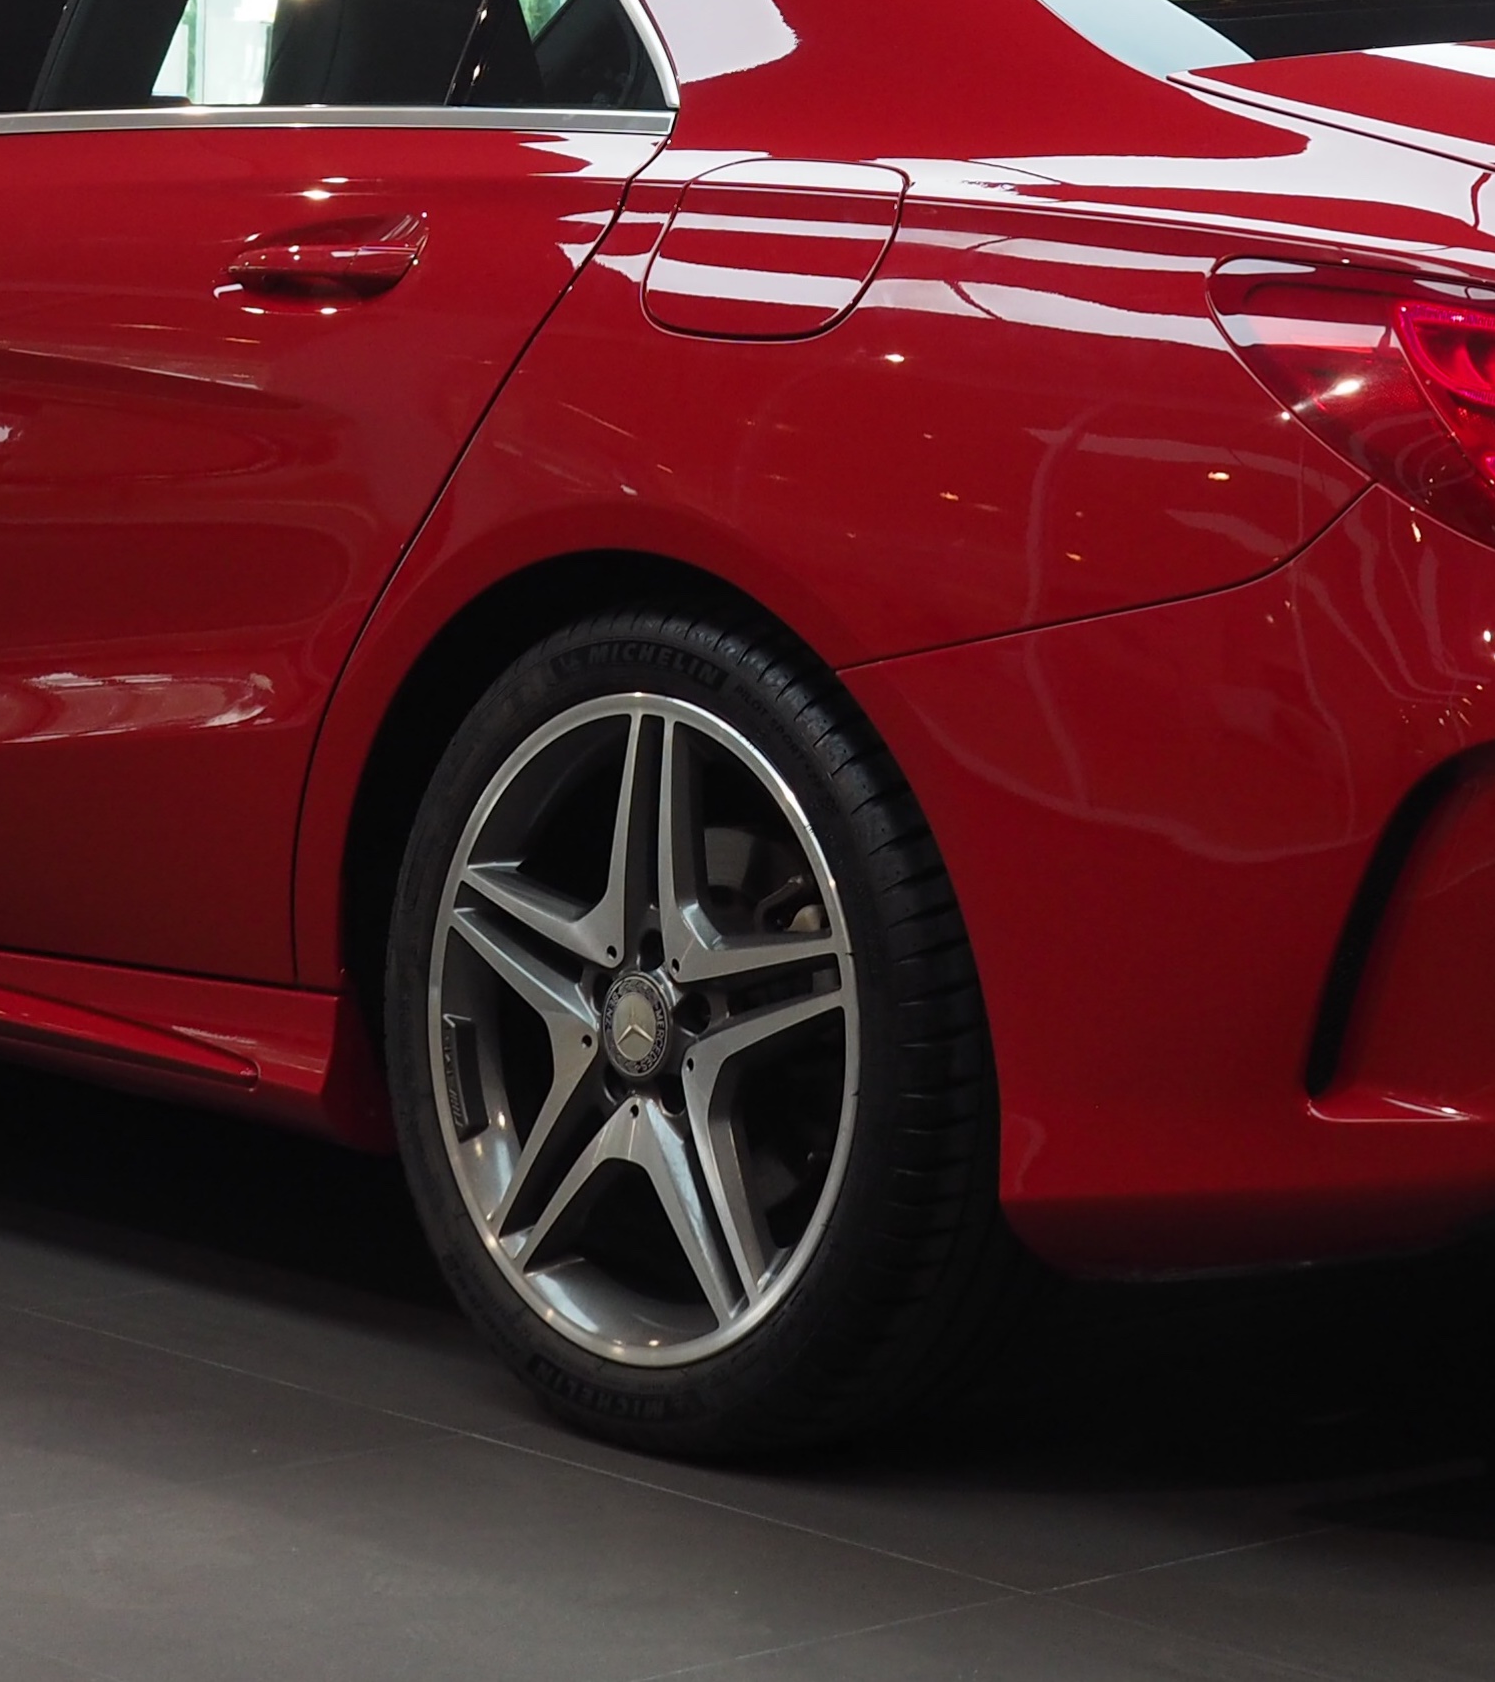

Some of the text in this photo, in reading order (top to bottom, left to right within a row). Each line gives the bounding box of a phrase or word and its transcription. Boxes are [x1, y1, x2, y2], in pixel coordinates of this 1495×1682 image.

[588, 642, 720, 685] MICHELIN
[735, 684, 769, 717] PILOT
[640, 1006, 665, 1071] MERCEDES
